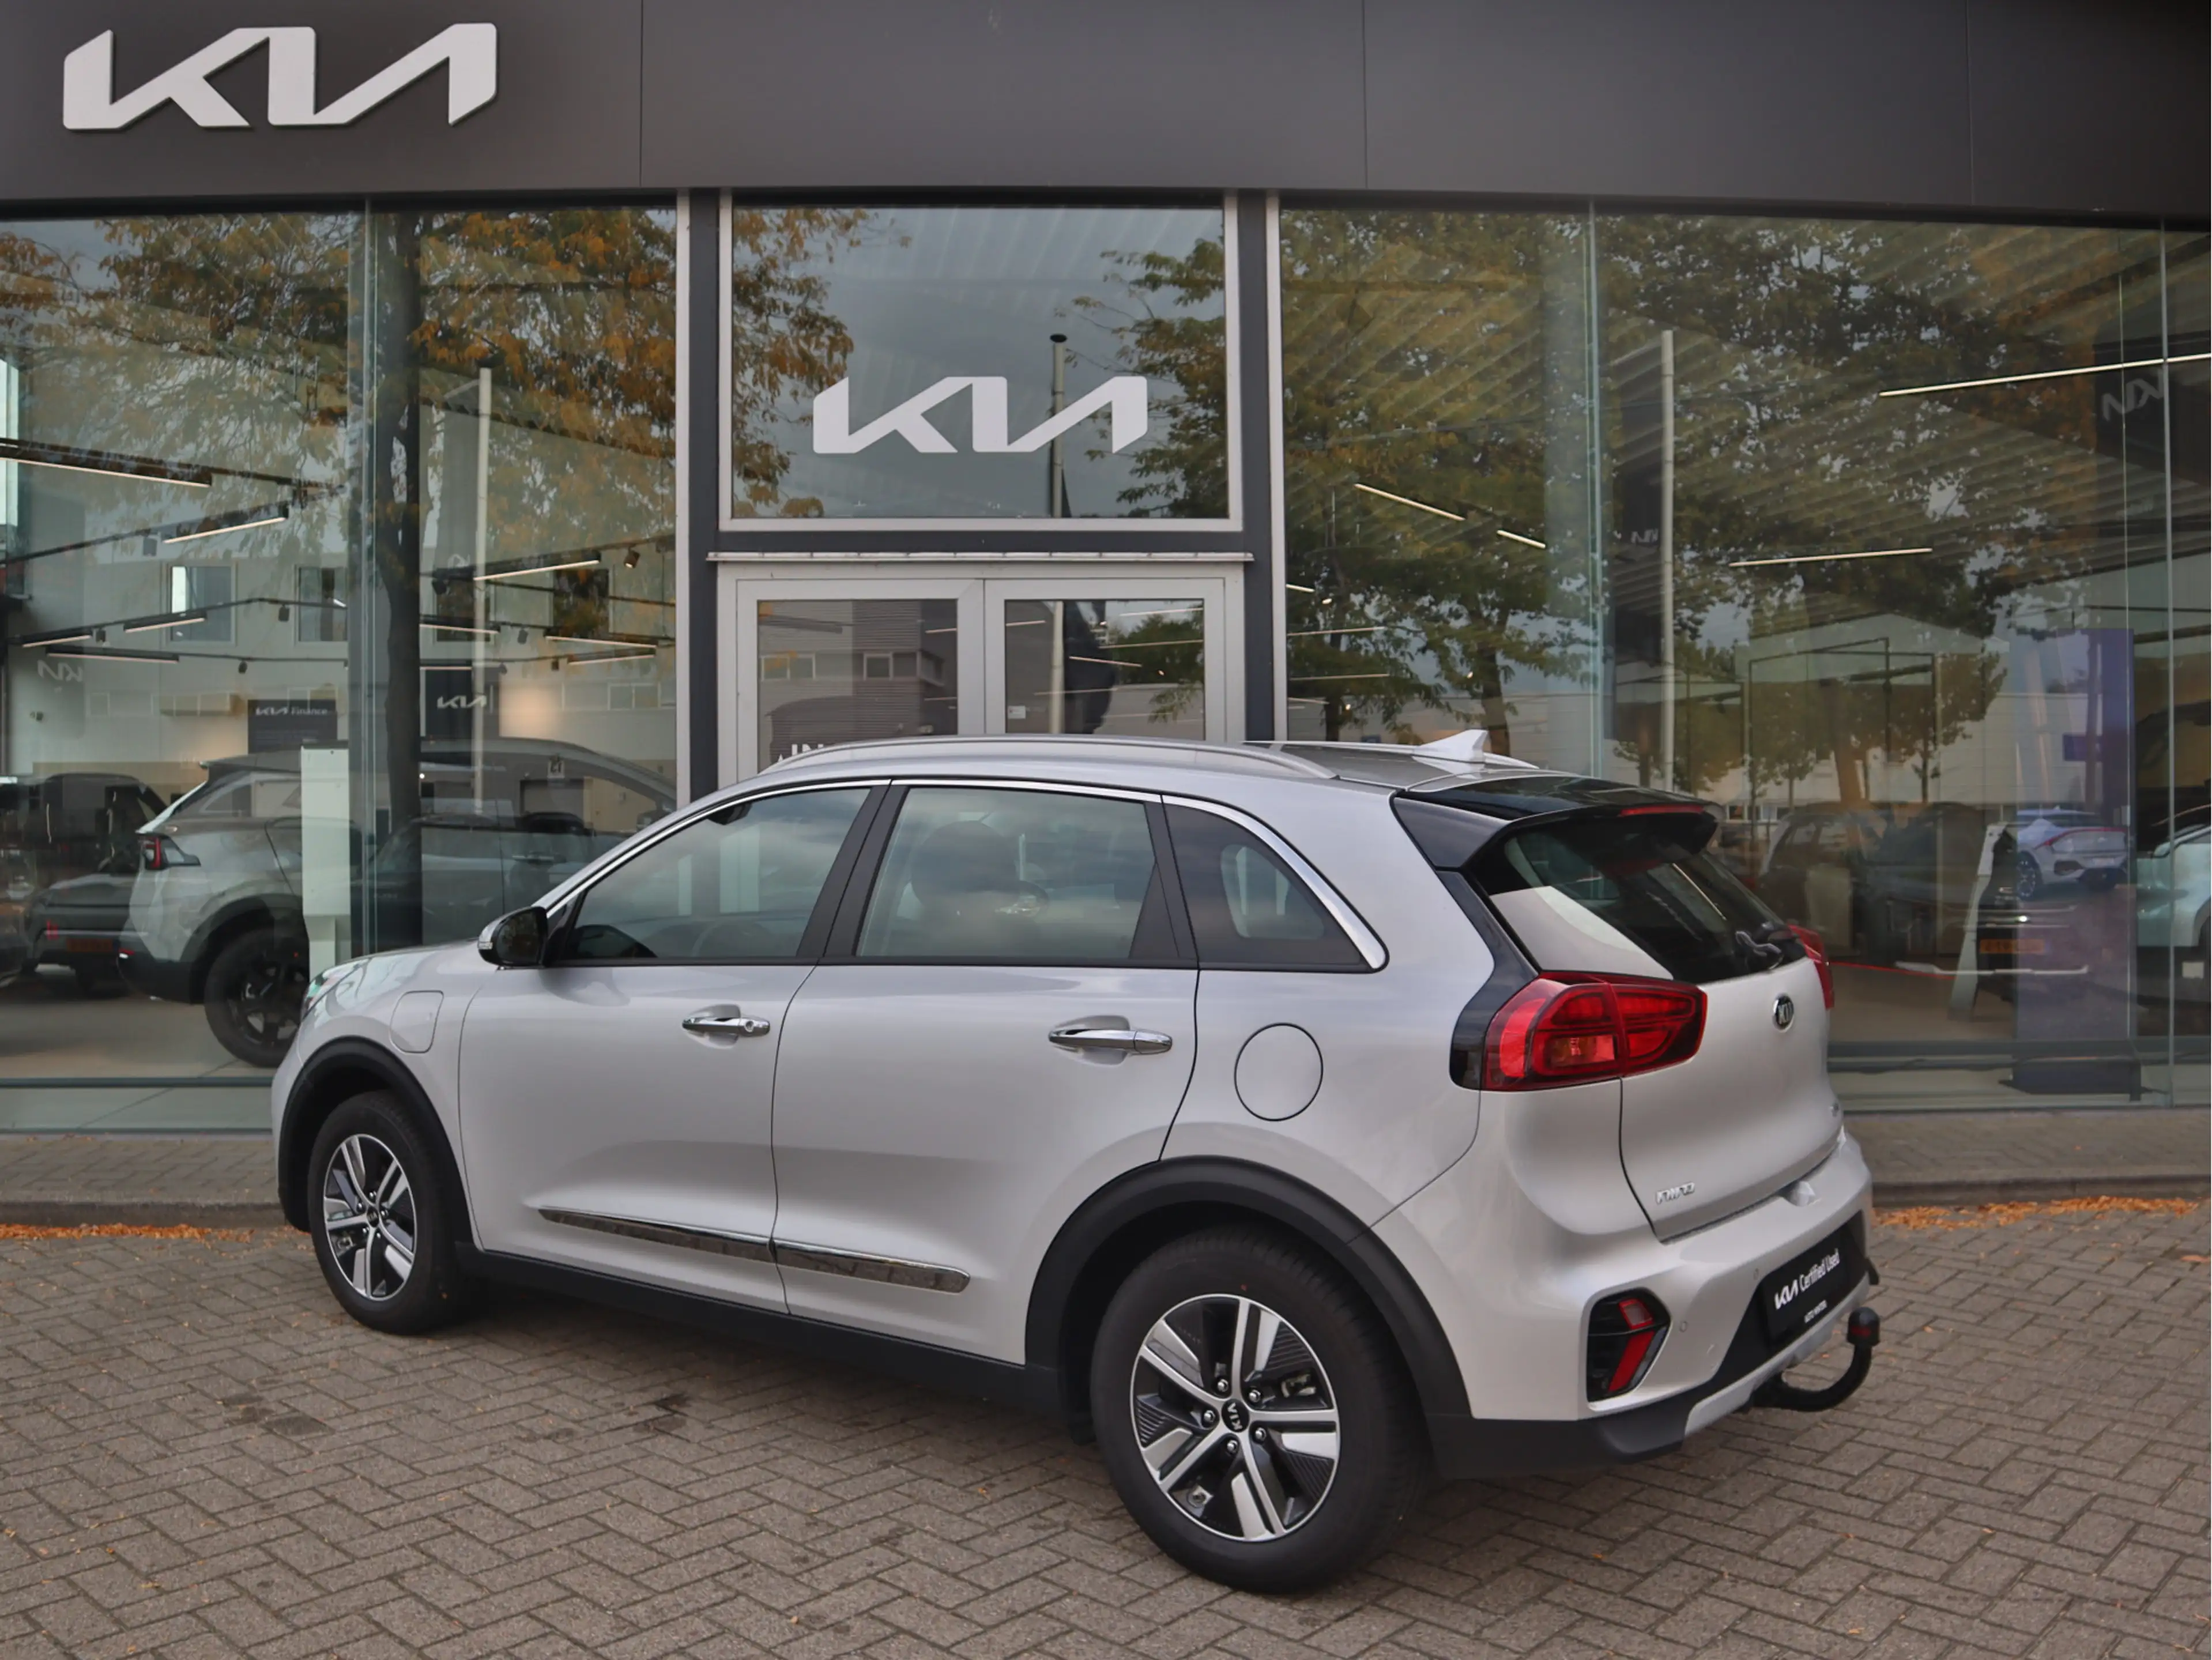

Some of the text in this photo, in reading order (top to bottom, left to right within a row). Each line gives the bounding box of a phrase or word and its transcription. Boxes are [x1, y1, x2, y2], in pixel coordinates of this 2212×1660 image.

[63, 22, 497, 130] KIA
[813, 376, 1148, 454] KIA
[255, 706, 328, 715] KIA Finance
[437, 695, 487, 708] KIA
[1774, 1278, 1799, 1310] KIA
[1799, 1259, 1826, 1292] Certified
[1825, 1247, 1840, 1272] Used
[1227, 1402, 1243, 1431] KIA
